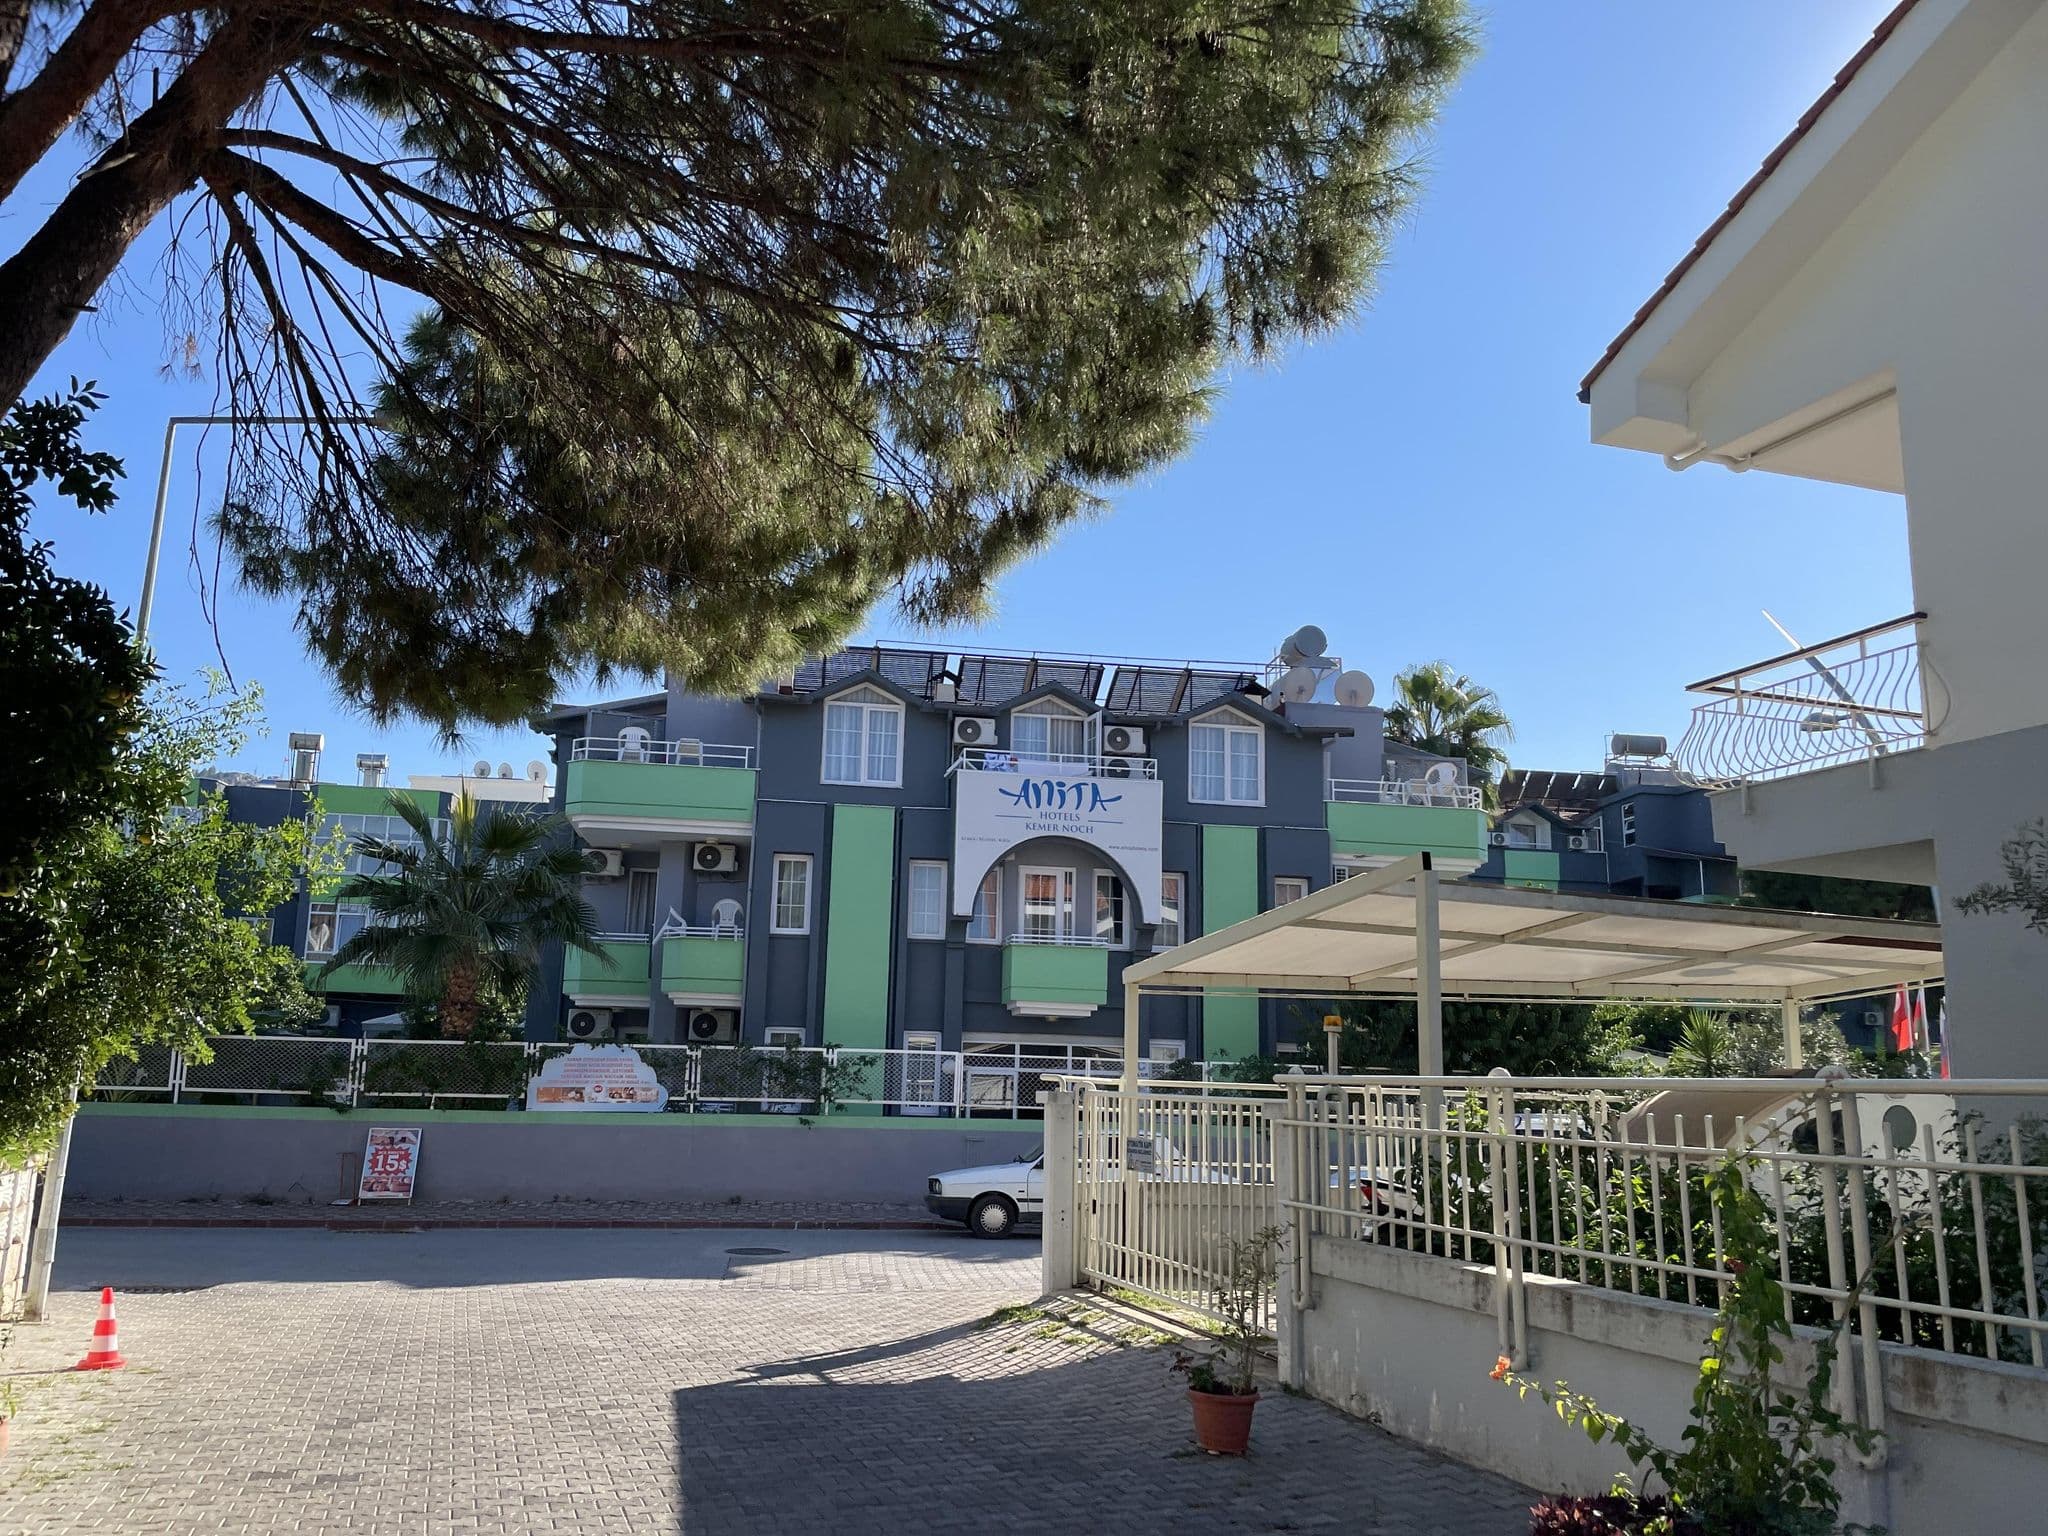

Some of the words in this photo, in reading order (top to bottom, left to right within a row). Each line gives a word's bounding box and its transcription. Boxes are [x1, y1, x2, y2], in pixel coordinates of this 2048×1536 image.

[1040, 811, 1081, 822] HOTELS
[1025, 822, 1060, 832] KEMER
[1062, 824, 1094, 834] NOCH
[374, 1154, 407, 1172] 15$
